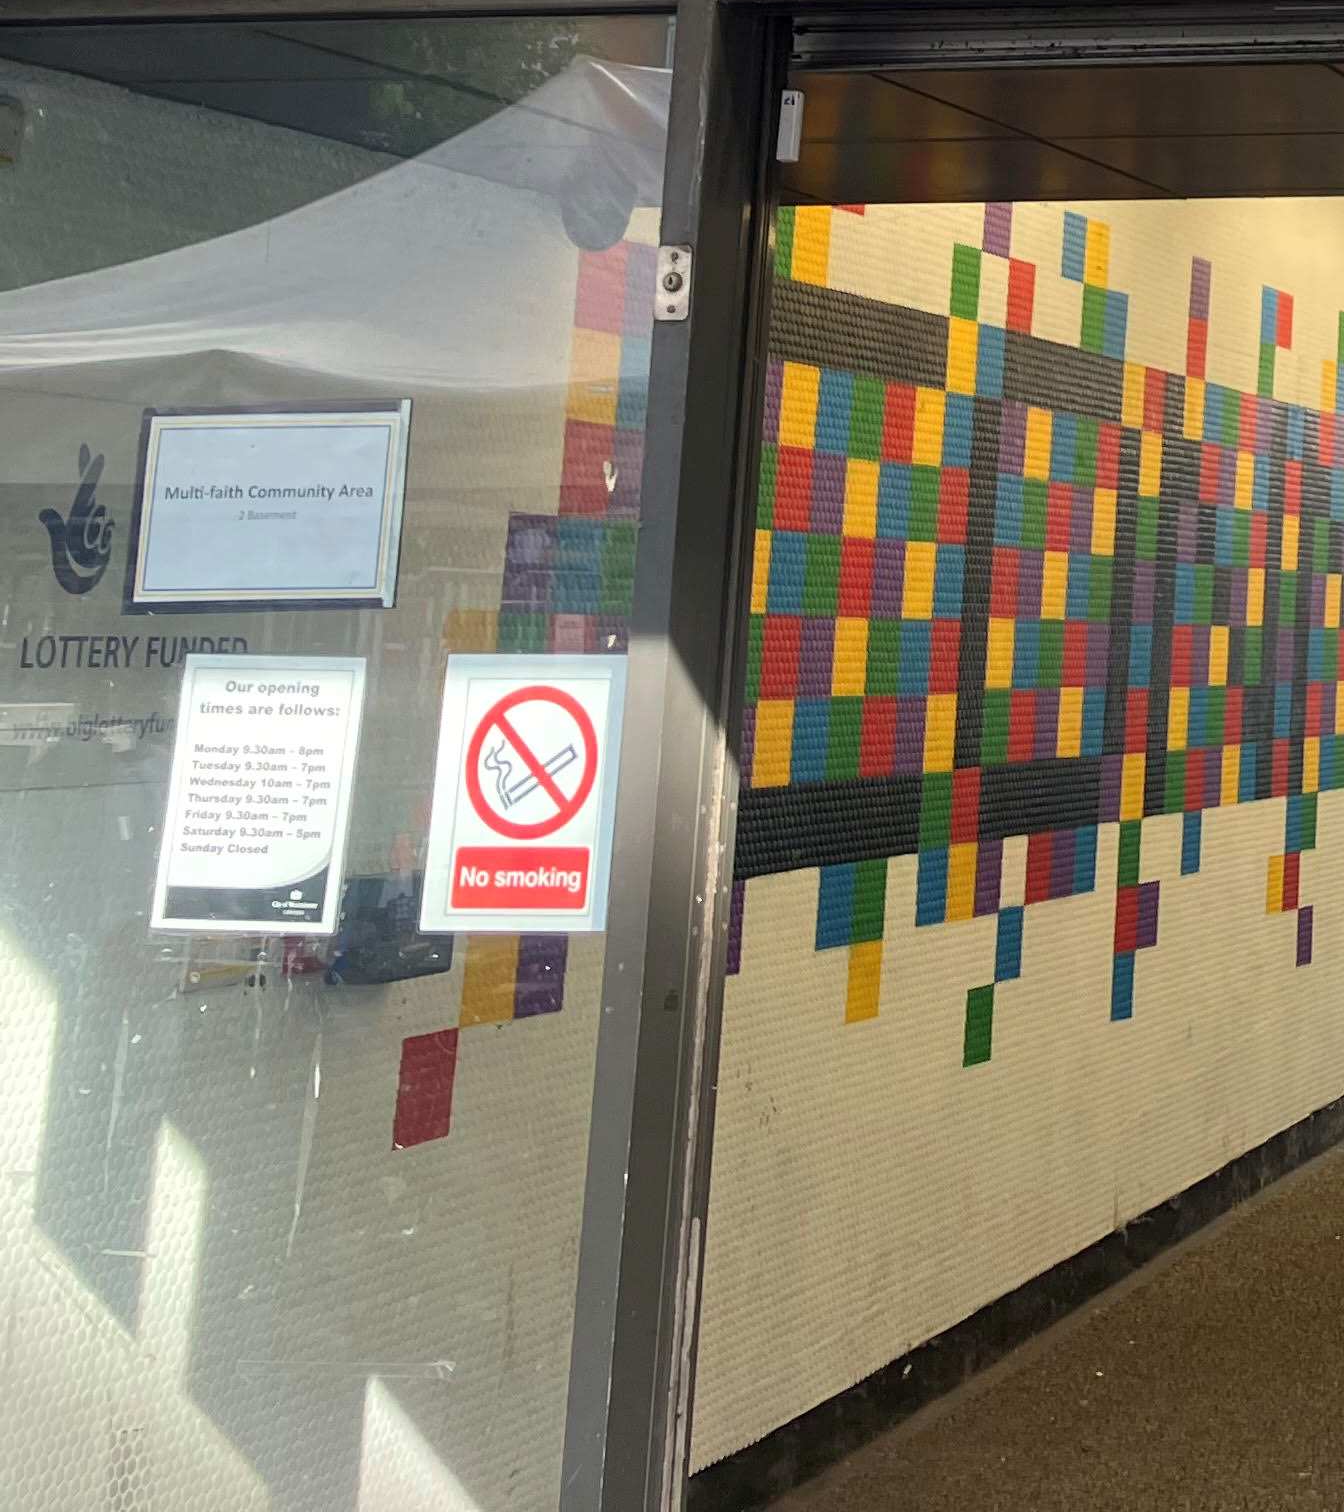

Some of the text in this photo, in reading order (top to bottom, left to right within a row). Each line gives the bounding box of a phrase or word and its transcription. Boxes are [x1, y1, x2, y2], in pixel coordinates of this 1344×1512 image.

[164, 484, 373, 501] Multi-faith Community Area
[20, 636, 139, 668] LOTTERY
[225, 680, 321, 697] Our opening
[200, 702, 341, 717] times are follows:
[194, 744, 239, 756] Monday
[243, 745, 285, 755] 9.30am
[192, 760, 241, 772] Tuesday
[244, 761, 288, 771] 9.30am
[301, 763, 326, 774] 7pm
[189, 777, 256, 789] Wednesday
[261, 778, 292, 788] 10am
[306, 779, 331, 791] 7pm
[188, 793, 242, 805] Thursday
[245, 794, 288, 804] 9.30am
[302, 795, 327, 807] 7pm
[184, 809, 222, 822] Friday
[225, 810, 268, 820] 9.30am
[282, 812, 307, 823] 7pm
[183, 826, 236, 838] Saturday
[180, 843, 269, 855] Sunday Closed
[459, 866, 581, 893] No smoking
